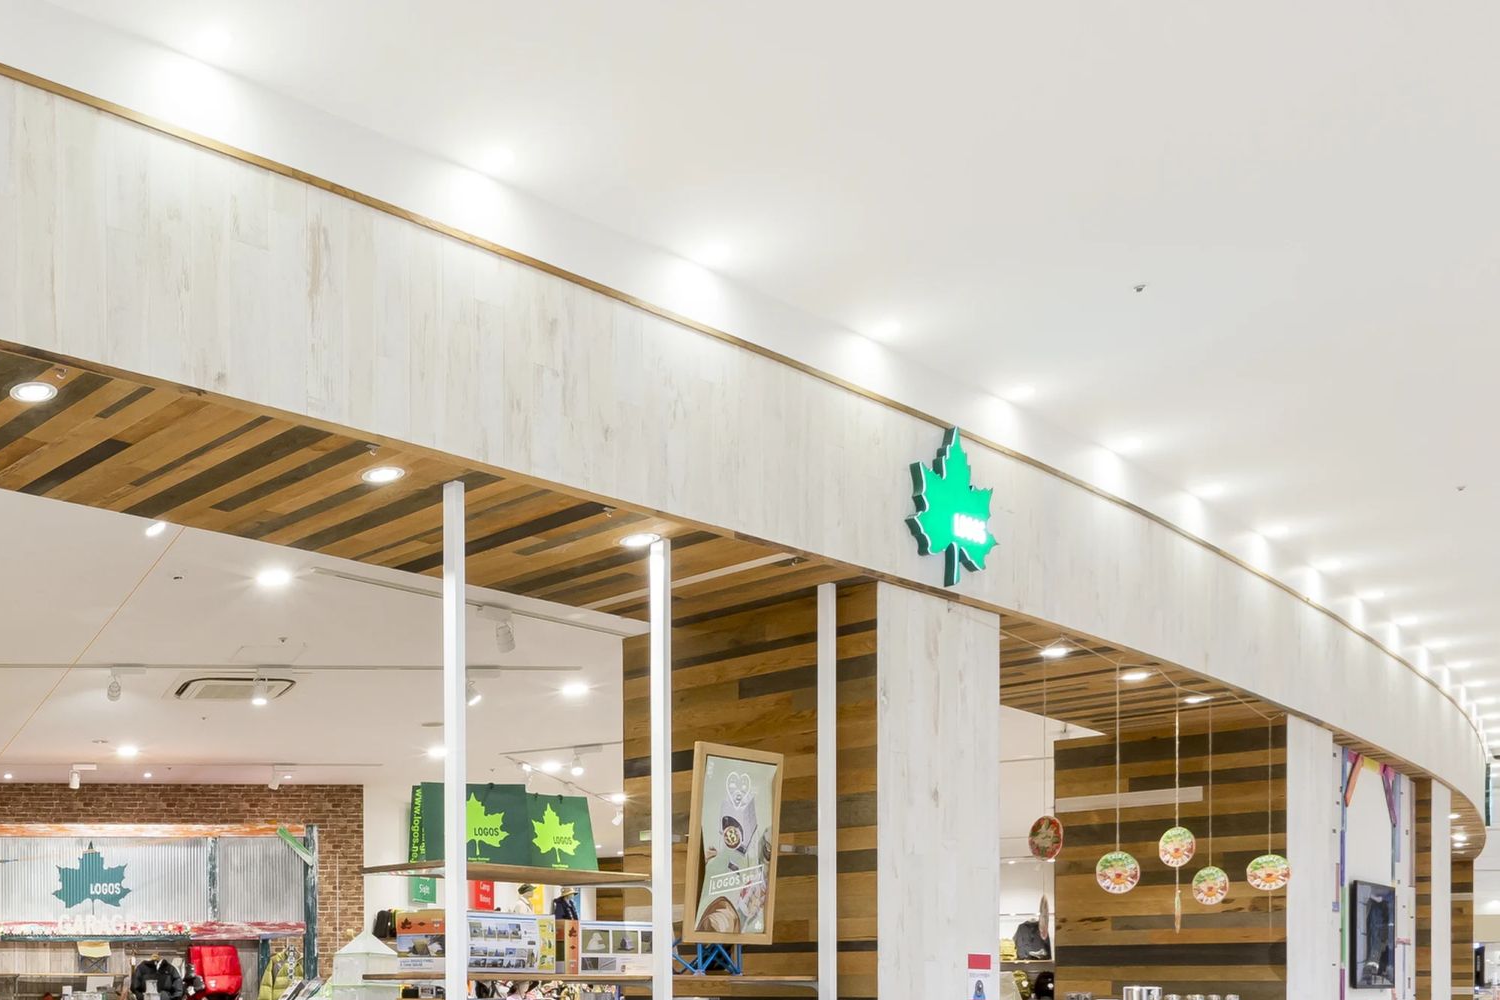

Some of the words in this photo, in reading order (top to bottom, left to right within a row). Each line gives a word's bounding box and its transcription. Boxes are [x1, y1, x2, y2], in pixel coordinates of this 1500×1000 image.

[473, 826, 500, 837] LOGOS
[552, 836, 573, 845] LOGOS
[89, 882, 121, 895] LOGOS
[711, 875, 740, 890] LOGOS
